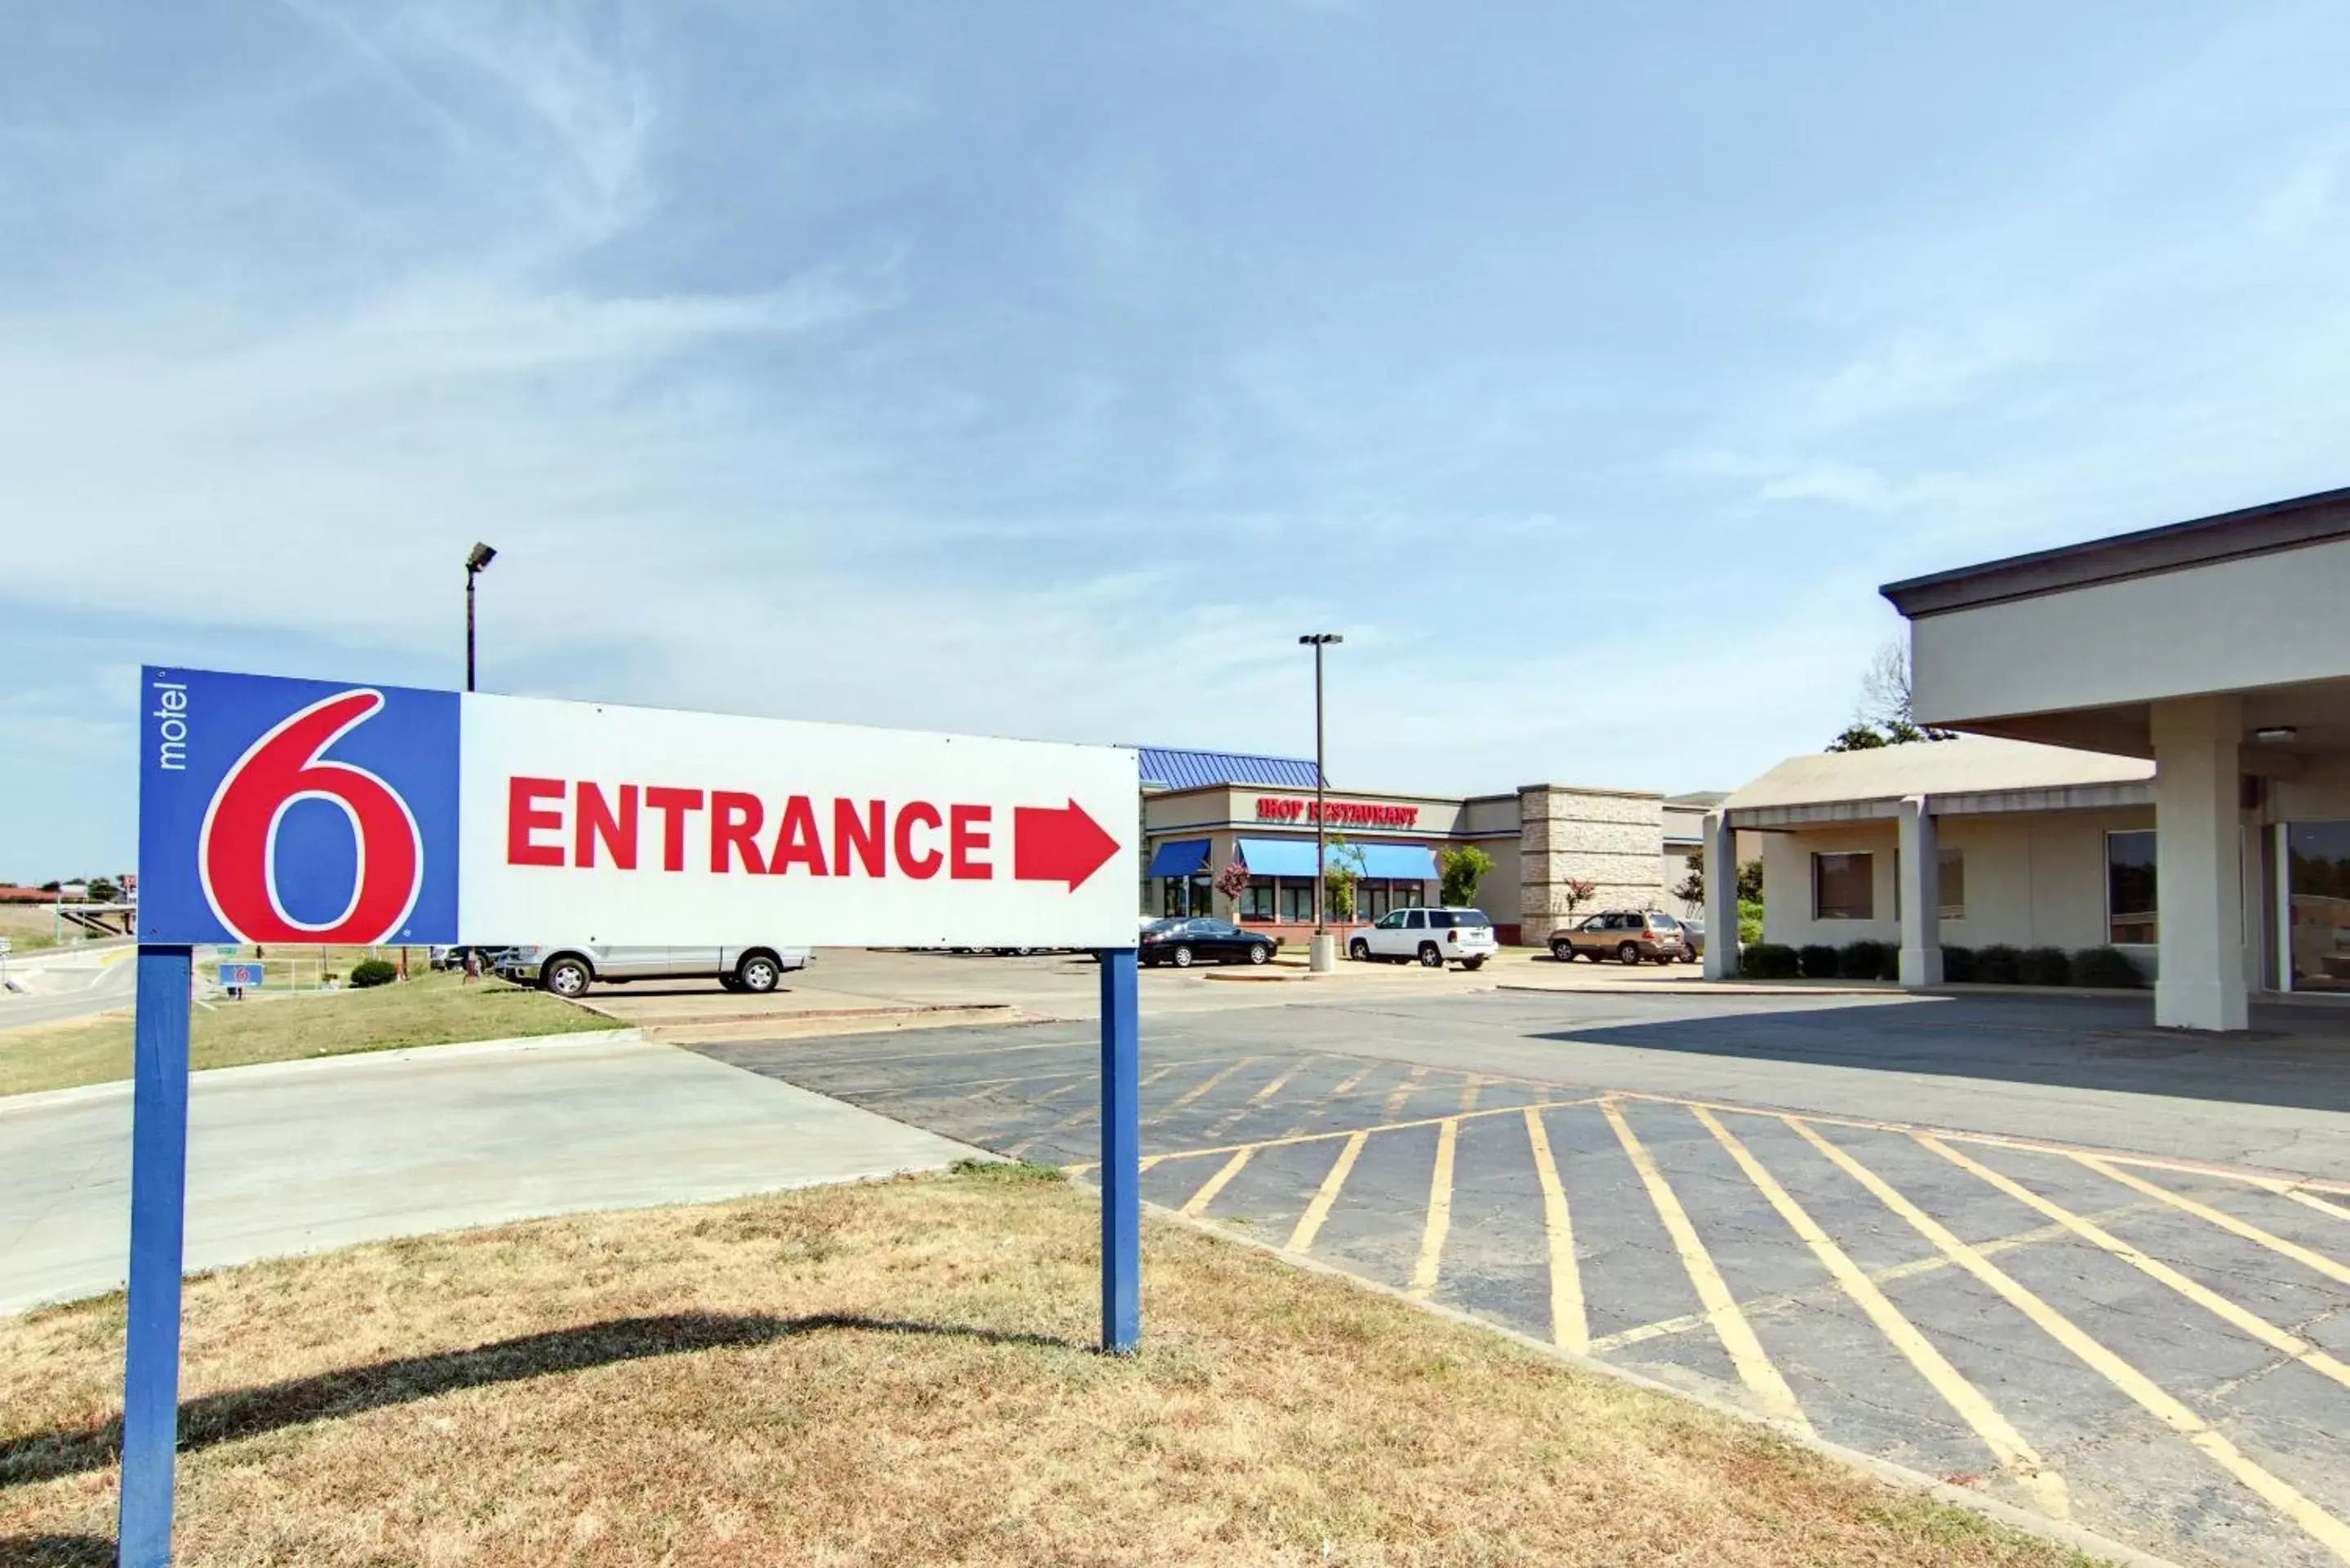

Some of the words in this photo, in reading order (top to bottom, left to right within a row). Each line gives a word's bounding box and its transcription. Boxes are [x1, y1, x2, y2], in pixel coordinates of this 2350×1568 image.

[153, 682, 187, 770] motel
[198, 688, 423, 944] 6
[508, 776, 993, 880] ENTRANCE
[1257, 797, 1304, 819] IHOP
[1308, 801, 1419, 824] RESTAURANT
